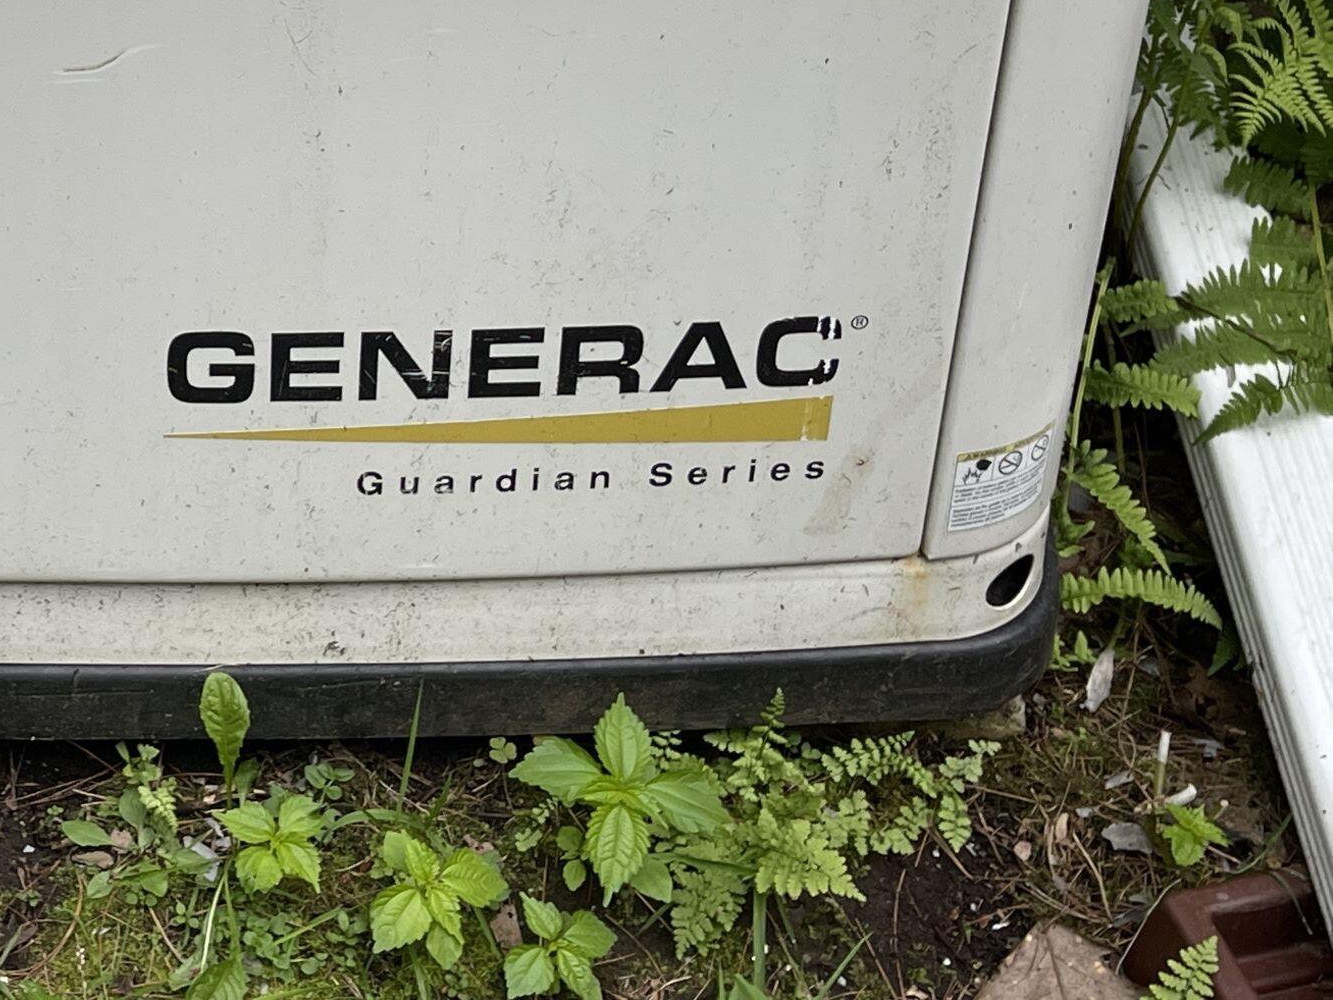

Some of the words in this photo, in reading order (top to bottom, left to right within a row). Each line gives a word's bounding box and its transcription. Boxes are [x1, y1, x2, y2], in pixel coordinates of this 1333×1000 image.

[166, 316, 842, 404] GENERAC
[357, 469, 610, 496] Guardian
[649, 460, 825, 487] Series
